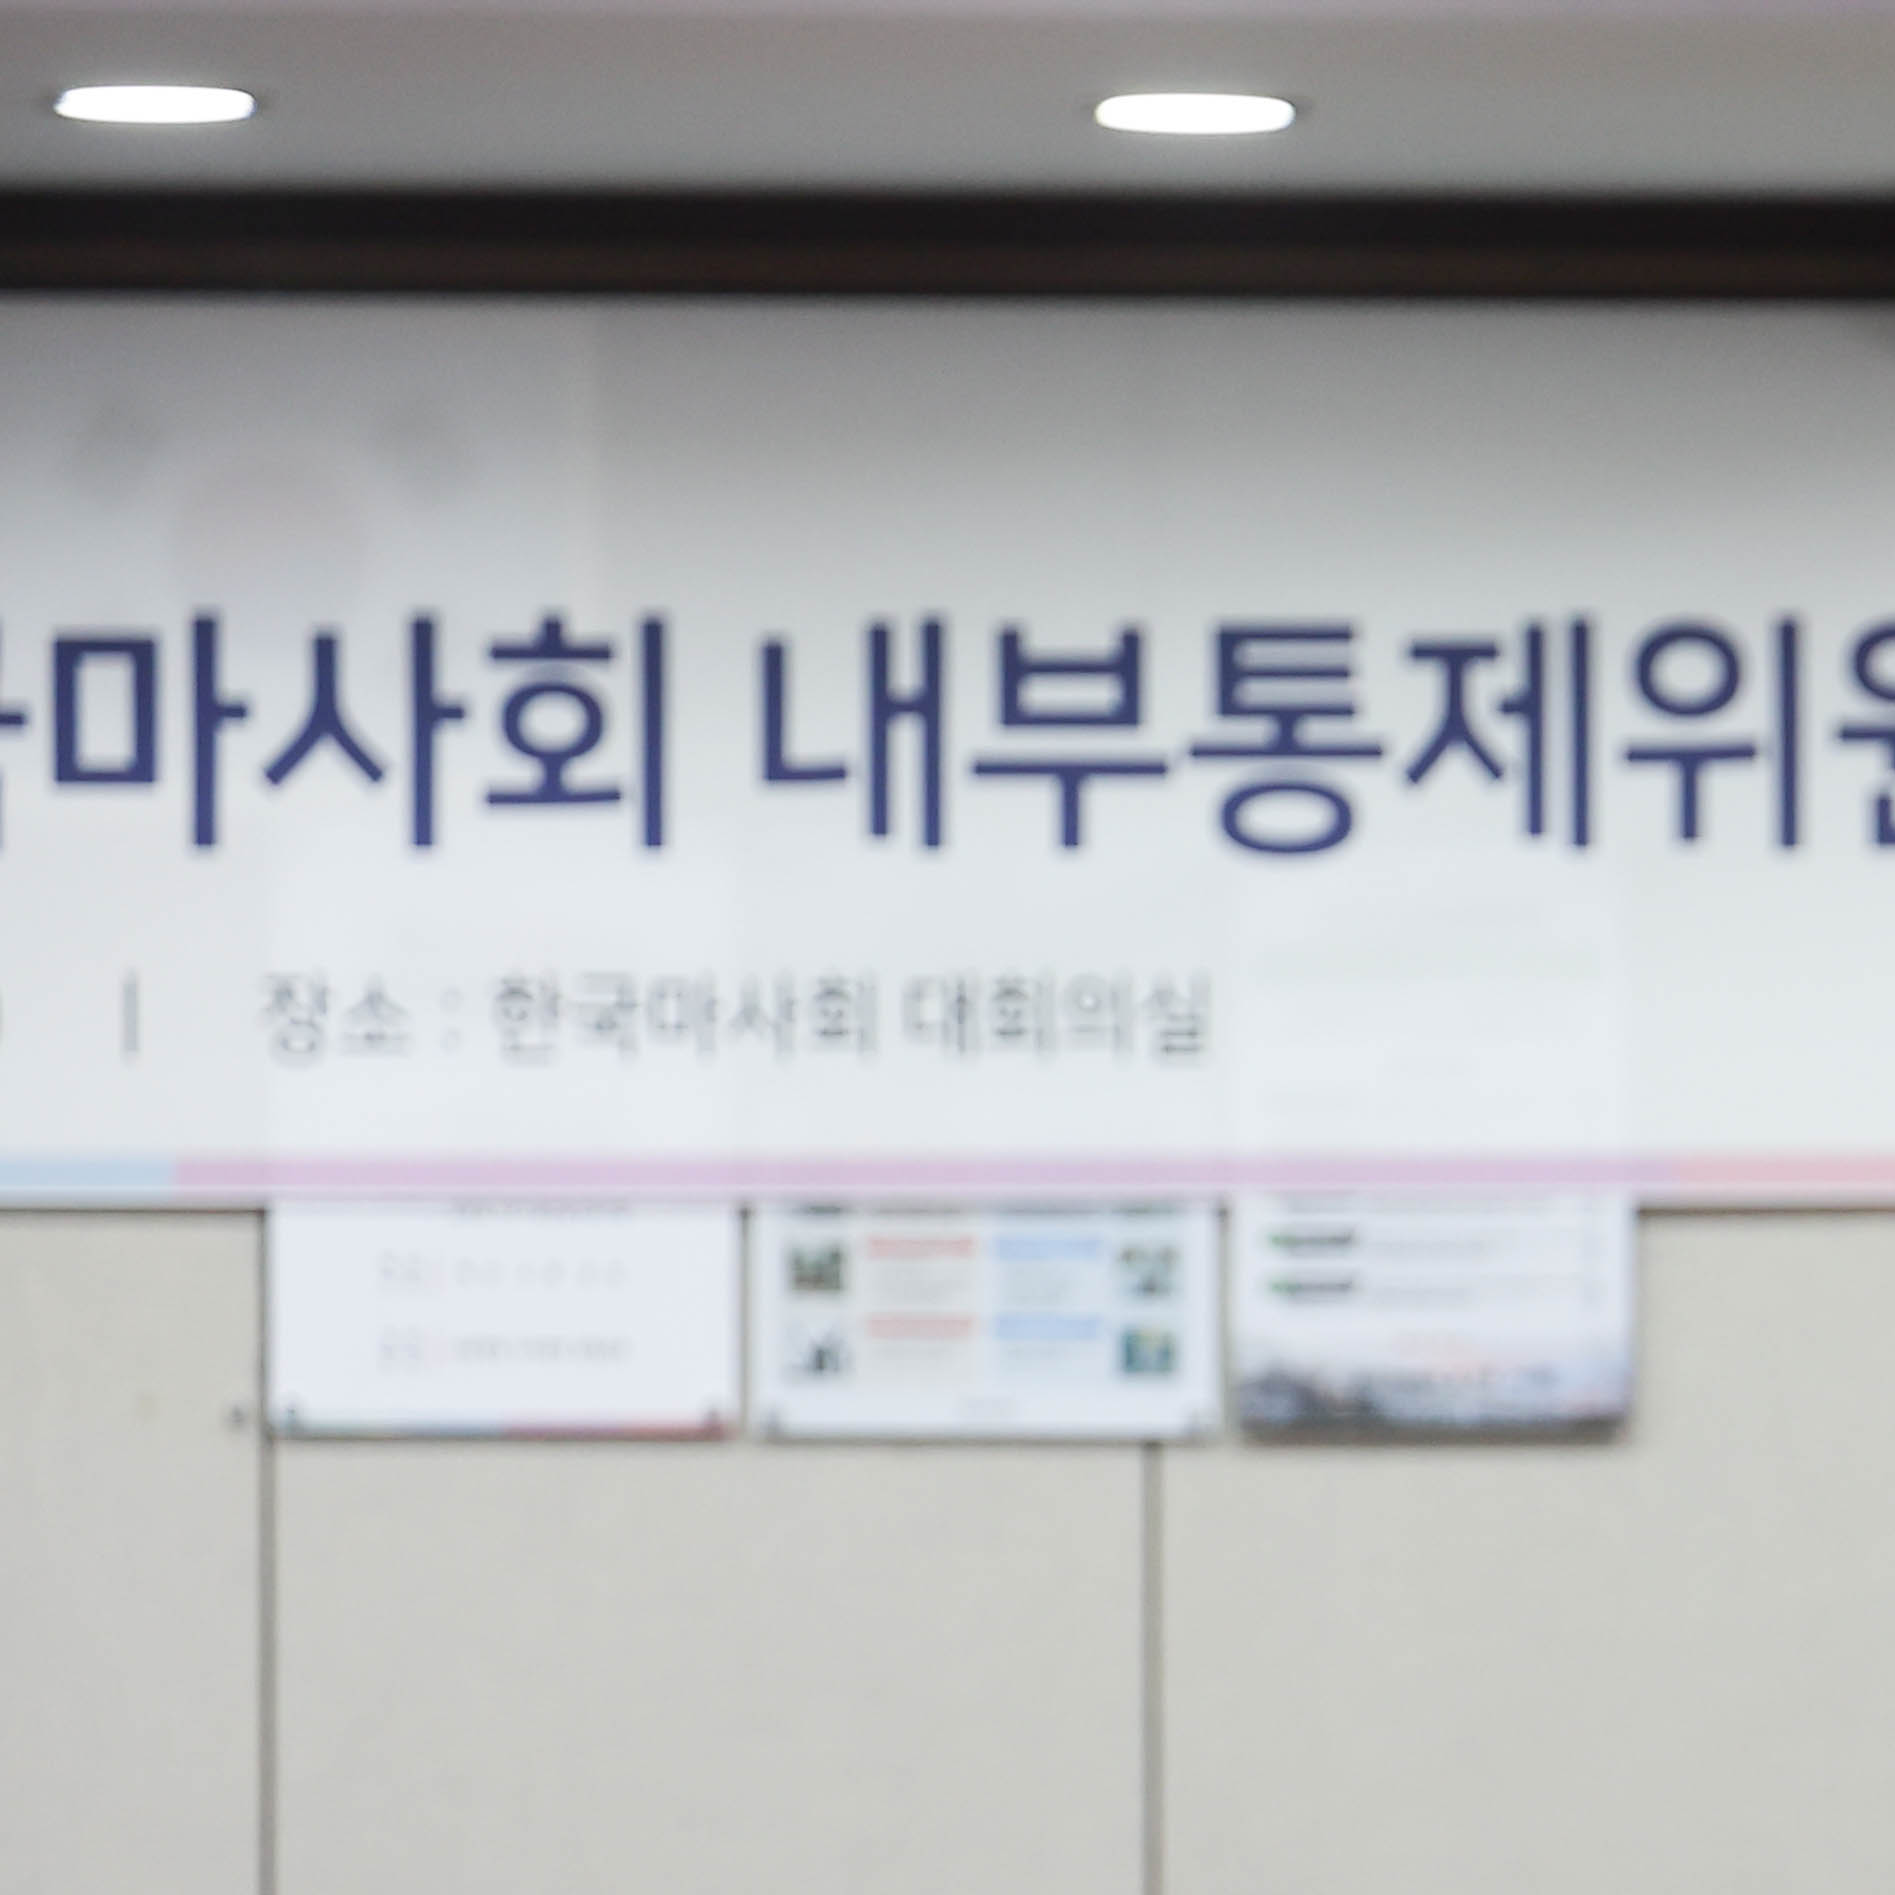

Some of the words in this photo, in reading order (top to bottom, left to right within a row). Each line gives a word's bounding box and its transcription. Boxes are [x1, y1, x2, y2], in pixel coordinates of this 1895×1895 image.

[0, 608, 670, 852] 마사회
[258, 972, 414, 1064] 장소
[490, 970, 882, 1064] 한국마사회
[898, 970, 1212, 1066] 대회의실
